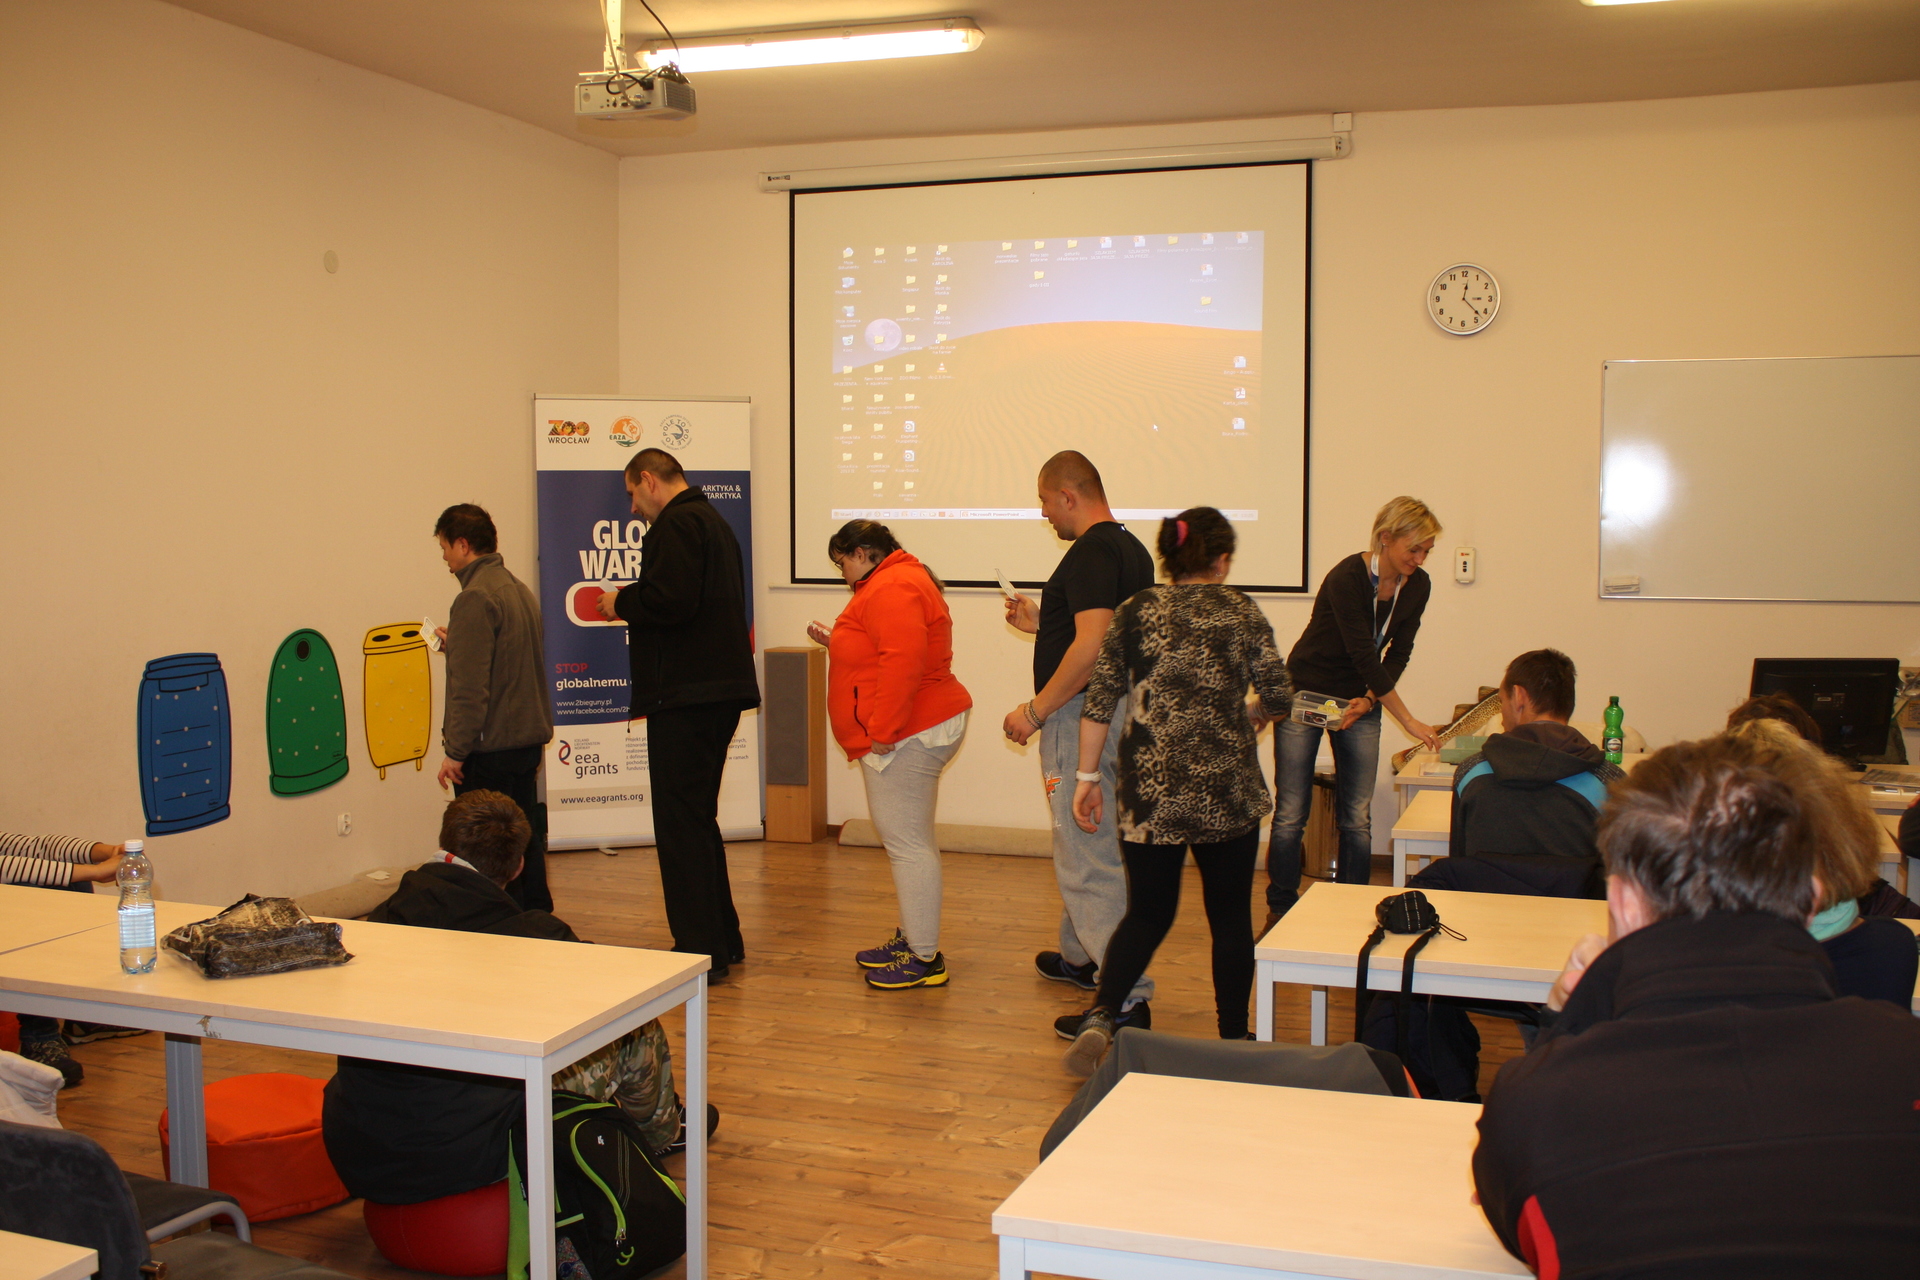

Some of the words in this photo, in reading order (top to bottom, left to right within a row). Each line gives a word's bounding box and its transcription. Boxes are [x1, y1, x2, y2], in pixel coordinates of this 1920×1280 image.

[1440, 283, 1447, 291] 10
[1484, 282, 1489, 290] 2
[1435, 295, 1441, 303] 9
[548, 420, 590, 436] ZOO
[548, 436, 590, 444] WROCŁAW
[701, 484, 734, 492] ARKTYKA
[735, 484, 742, 492] &
[704, 492, 742, 500] TARKTYKA
[593, 520, 652, 549] GLO
[555, 662, 589, 674] STOP
[556, 677, 628, 691] globalnemu
[575, 753, 600, 764] eea
[575, 763, 619, 779] grants
[560, 792, 644, 804] www.eeagrants.org
